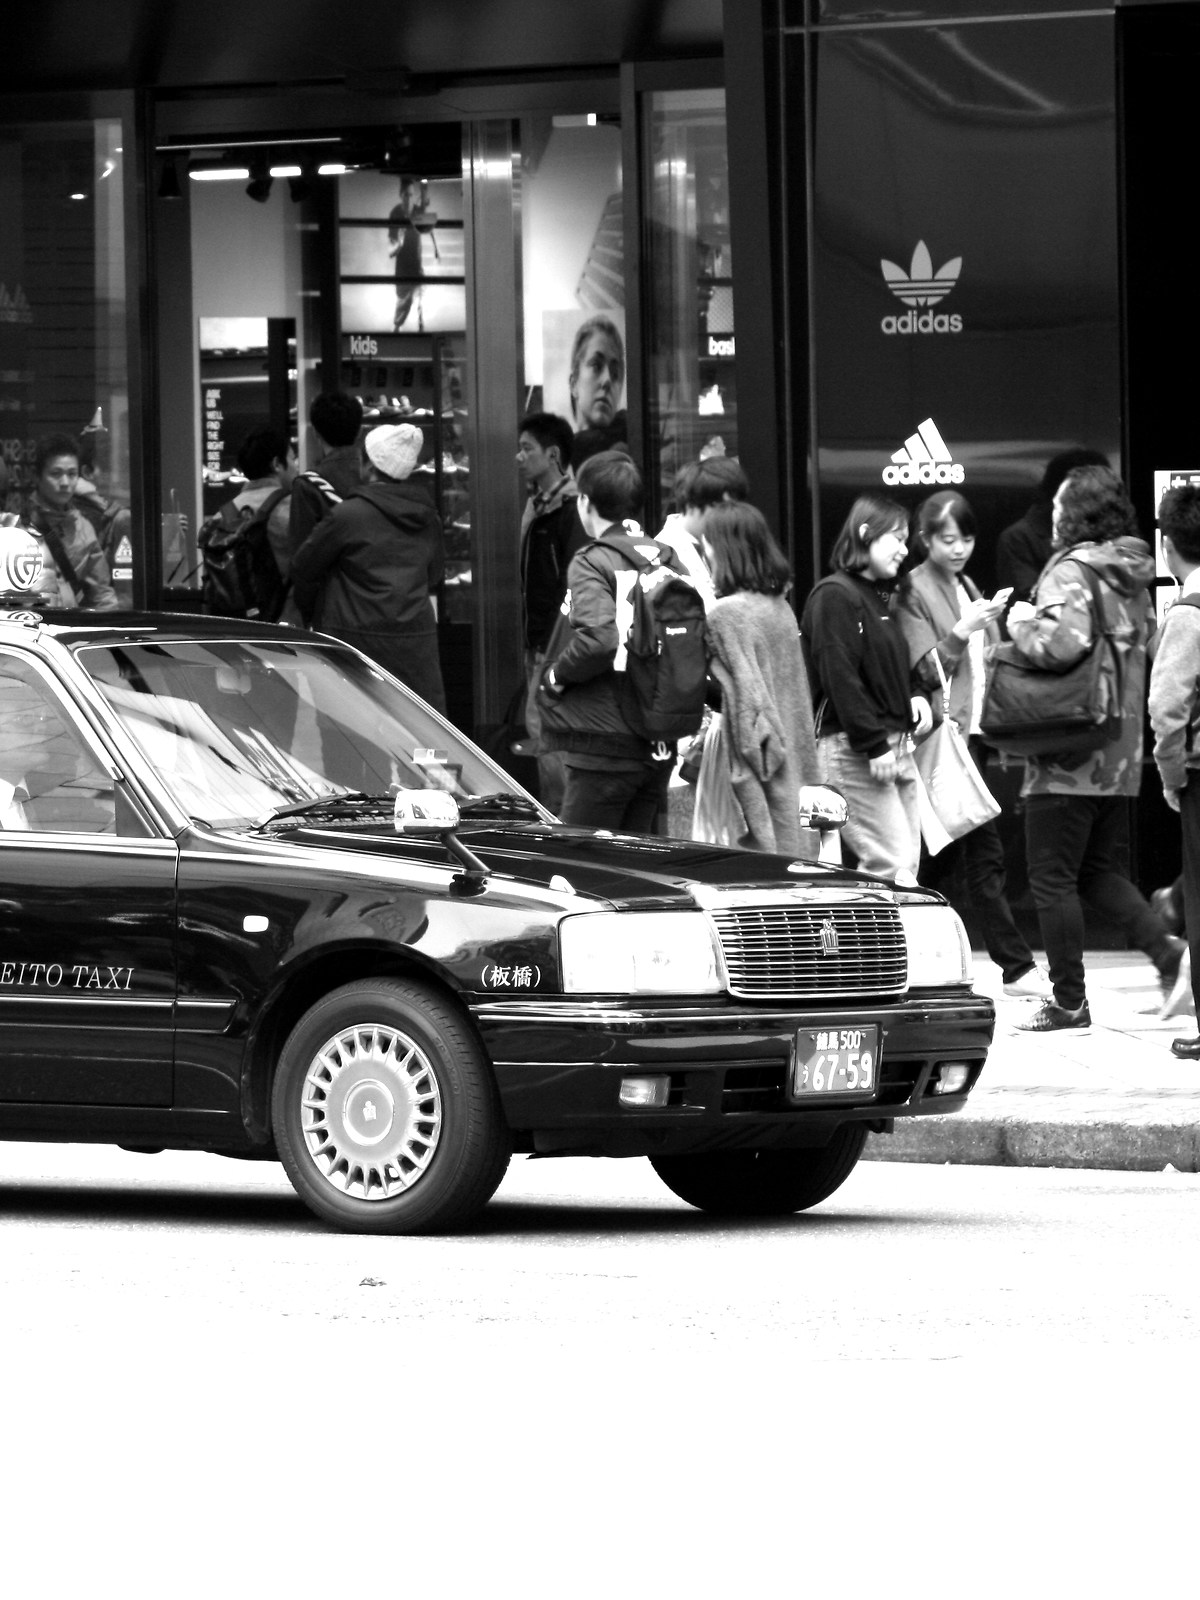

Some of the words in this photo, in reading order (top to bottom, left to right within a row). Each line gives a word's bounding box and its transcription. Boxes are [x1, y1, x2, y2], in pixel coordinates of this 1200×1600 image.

[881, 310, 963, 334] adidas
[350, 335, 378, 356] kids
[882, 460, 965, 486] adidas
[71, 965, 135, 991] TAXI
[481, 965, 541, 988] (板橋)
[840, 1030, 861, 1050] 500
[812, 1052, 873, 1091] 67-59
